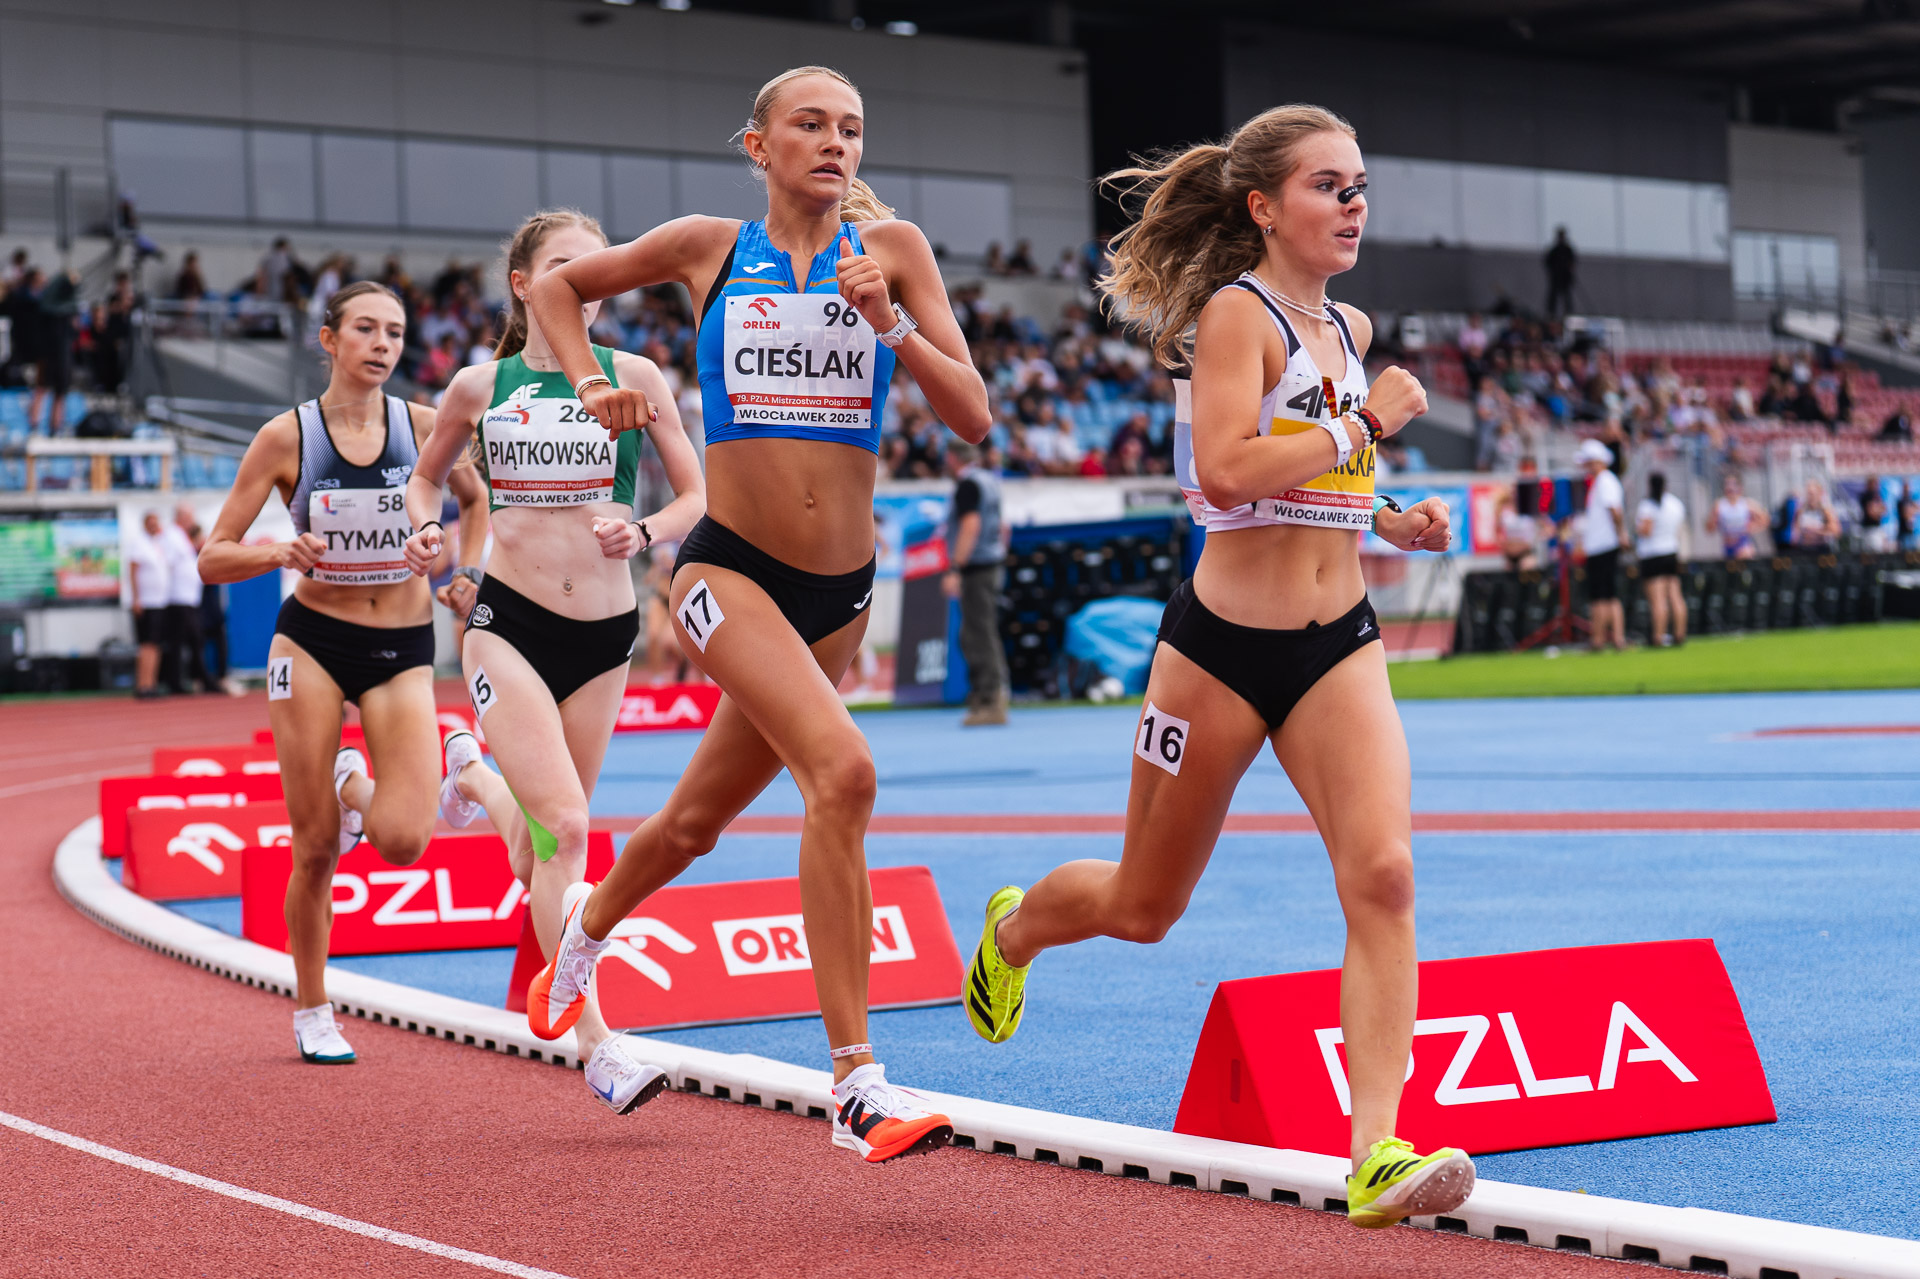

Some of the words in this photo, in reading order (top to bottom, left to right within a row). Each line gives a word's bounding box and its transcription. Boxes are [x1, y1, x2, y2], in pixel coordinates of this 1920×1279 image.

[823, 301, 859, 328] 96
[742, 321, 781, 331] ORLEN
[734, 342, 866, 380] CIEŚLAK
[736, 395, 749, 403] 79.
[750, 395, 770, 404] PZLA
[771, 396, 822, 406] Mistrzostwa
[823, 398, 848, 407] Polski
[848, 399, 862, 407] U20
[486, 415, 521, 424] polanik
[739, 409, 827, 423] WŁOCŁAWEK
[829, 412, 859, 424] 2025
[489, 441, 612, 471] PIĄTKOWSKA
[508, 481, 523, 489] PZLA
[567, 481, 588, 489] Polski
[589, 479, 602, 487] U20
[503, 493, 571, 503] WŁOCŁAWEK
[572, 491, 599, 502] 2025
[1288, 491, 1307, 502] PZLA
[1308, 494, 1347, 504] Mistrzostwa
[1347, 497, 1364, 506] Polski
[1364, 498, 1374, 507] U2
[1274, 504, 1350, 524] WŁOCŁAWEK
[323, 526, 413, 551] TYMAN
[323, 572, 389, 583] WŁOCŁAWEK
[684, 587, 712, 640] 17
[269, 664, 289, 693] 14
[1143, 715, 1184, 763] 16
[732, 917, 898, 964] ORN
